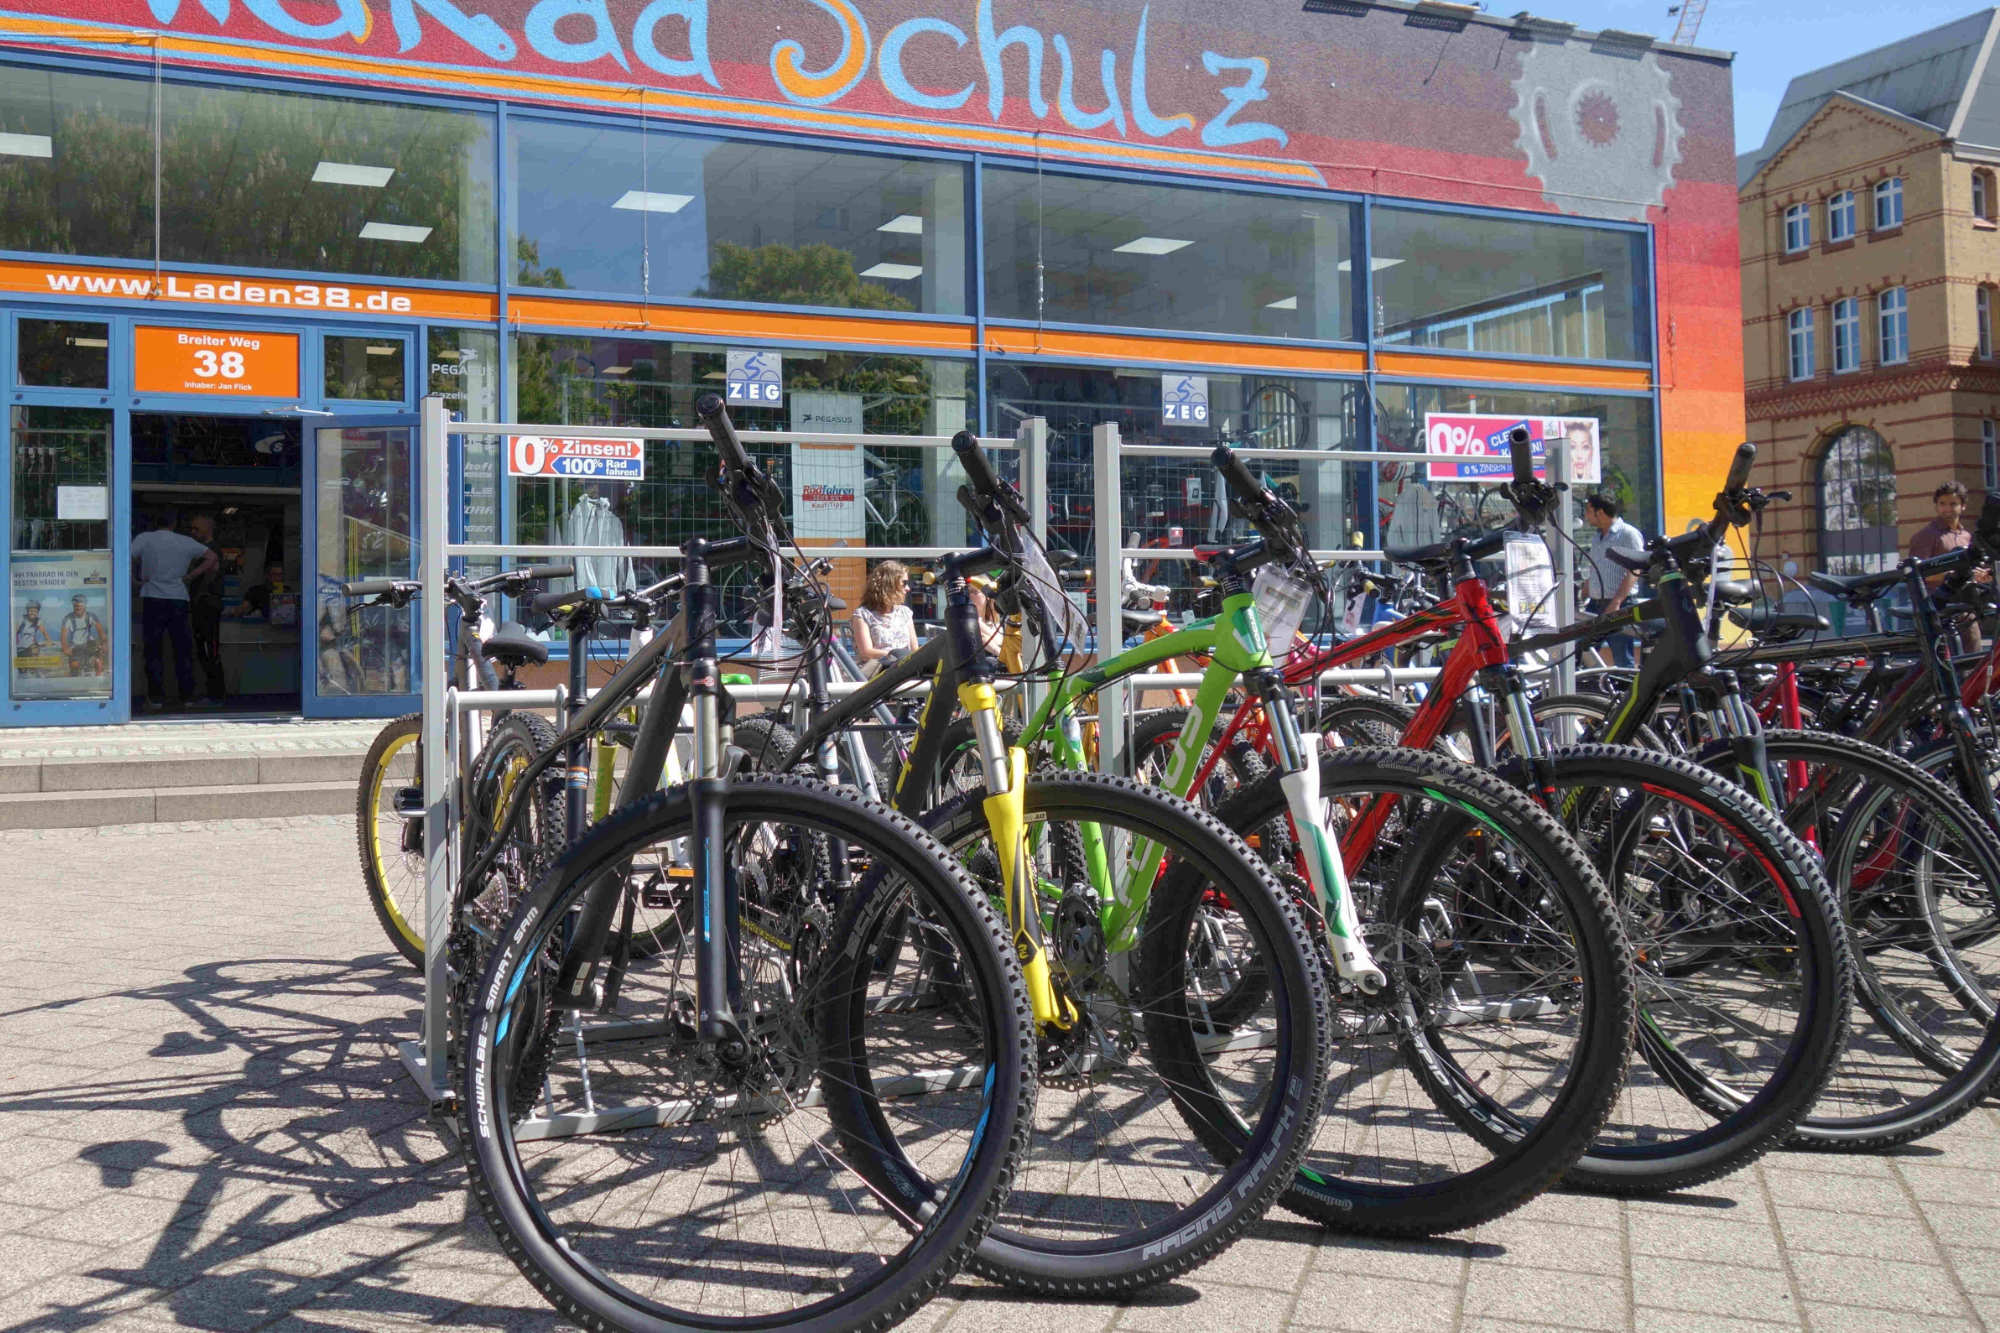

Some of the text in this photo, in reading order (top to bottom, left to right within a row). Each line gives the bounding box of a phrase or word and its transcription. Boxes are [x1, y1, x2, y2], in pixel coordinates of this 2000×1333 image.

[46, 274, 412, 312] www.Laden38.de
[178, 333, 260, 350] Breiter Weg
[192, 350, 246, 379] 38
[729, 383, 780, 400] ZEG
[815, 415, 853, 424] PEGASUS
[1165, 404, 1207, 420] ZEG
[1430, 422, 1485, 456] 0%
[562, 440, 632, 456] Zinsen!
[562, 459, 627, 475] 100% Rad
[606, 467, 639, 476] fahren!
[1700, 785, 1810, 890] SCHWALBE
[475, 906, 539, 1139] SCHWALBE SMART SAM
[1142, 1104, 1295, 1261] RACING RALPH
